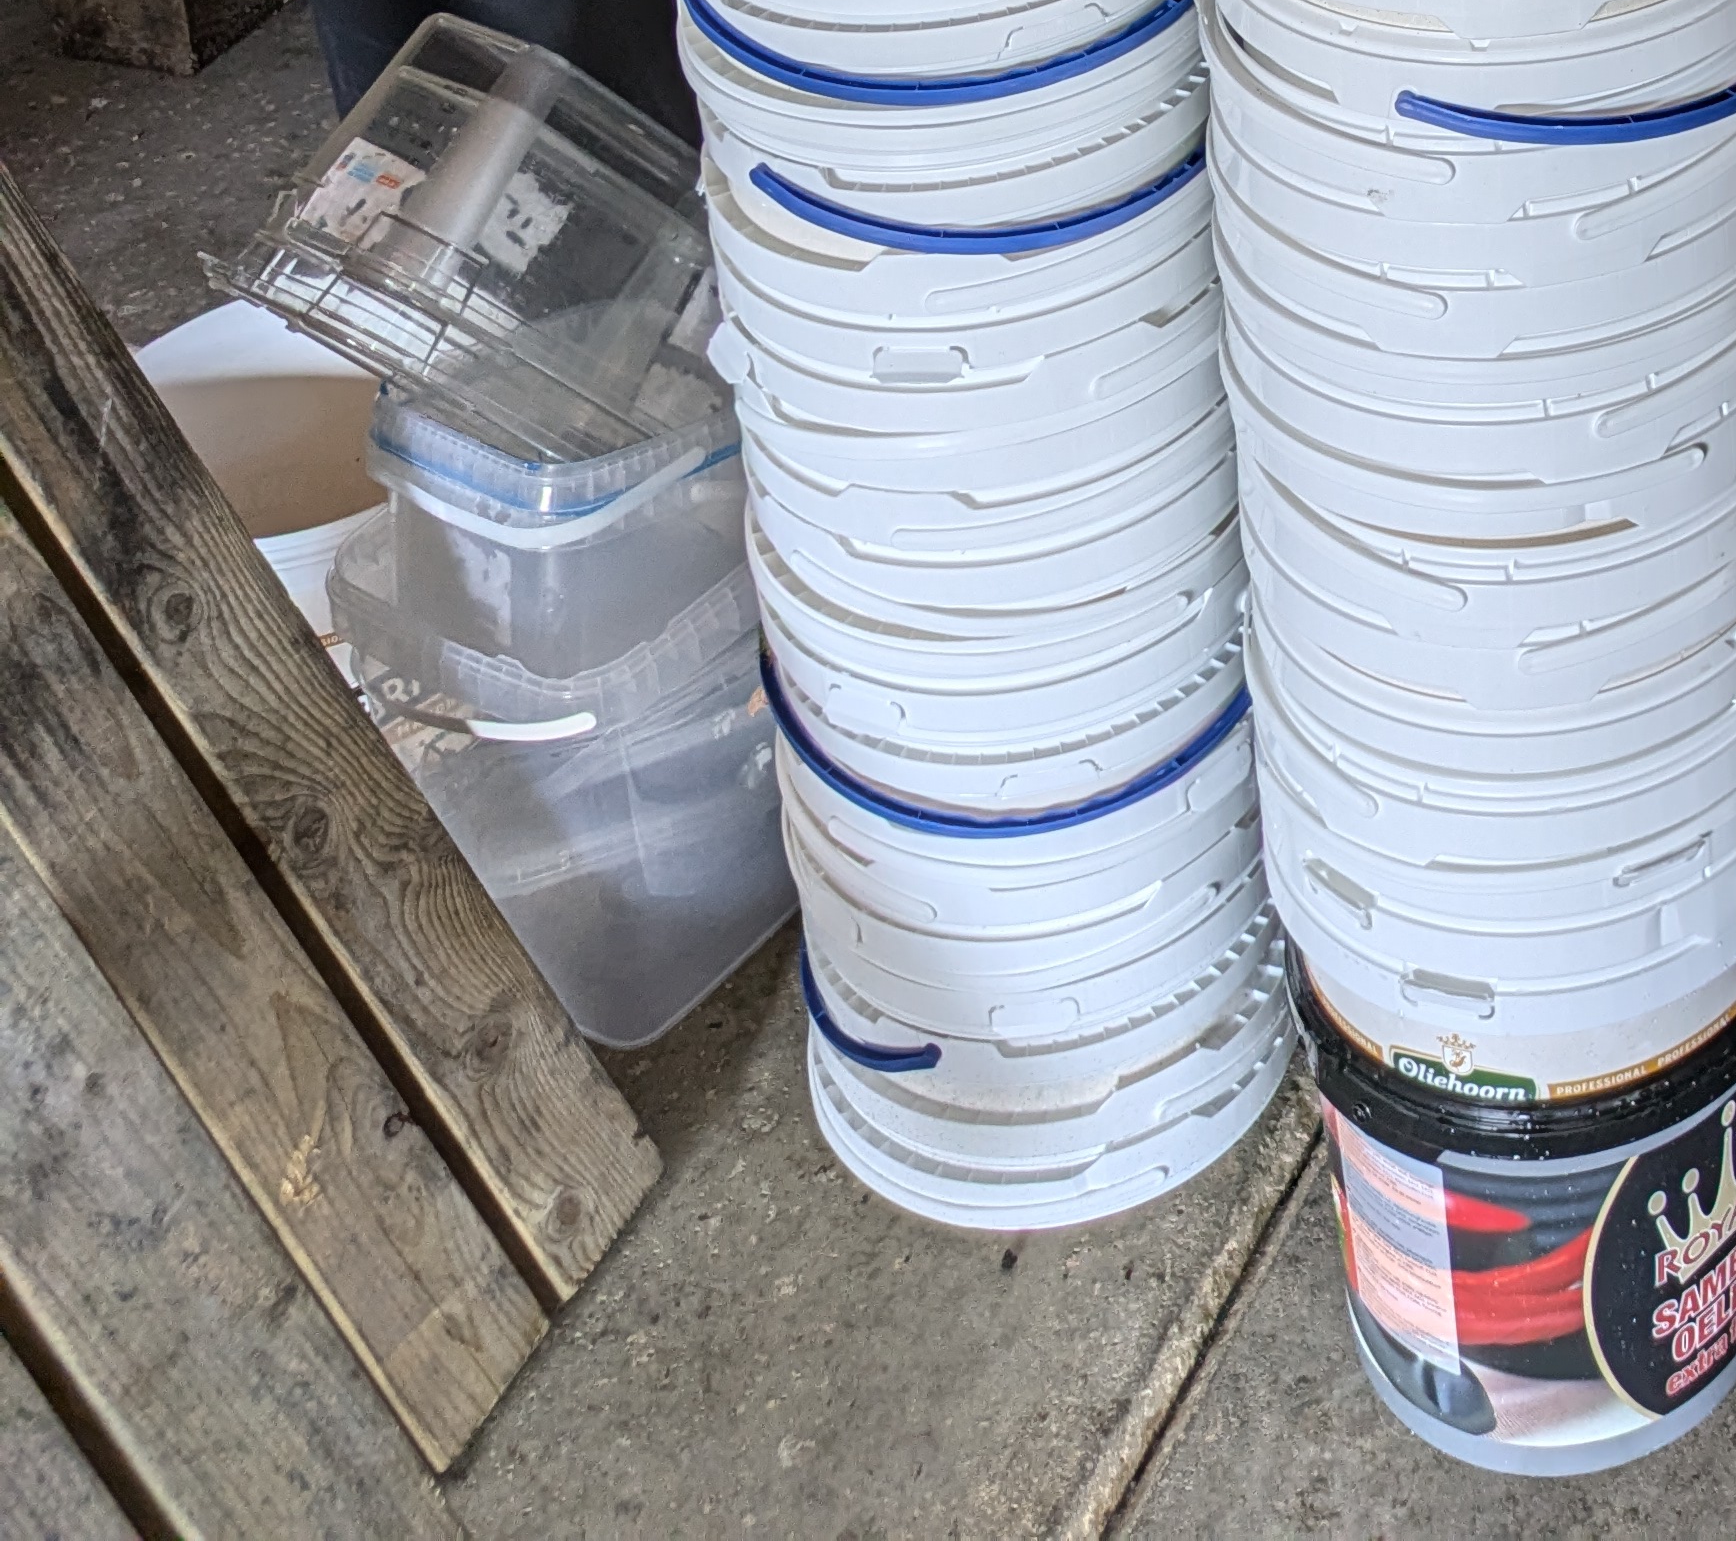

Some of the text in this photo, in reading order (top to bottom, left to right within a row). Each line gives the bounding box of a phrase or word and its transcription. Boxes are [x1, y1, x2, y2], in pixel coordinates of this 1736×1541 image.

[1657, 1013, 1731, 1066] PROFESSIONAL
[1397, 1057, 1528, 1101] Oliehoorn
[1555, 1066, 1647, 1097] PROFESSIONAL
[1665, 1331, 1728, 1396] extra
